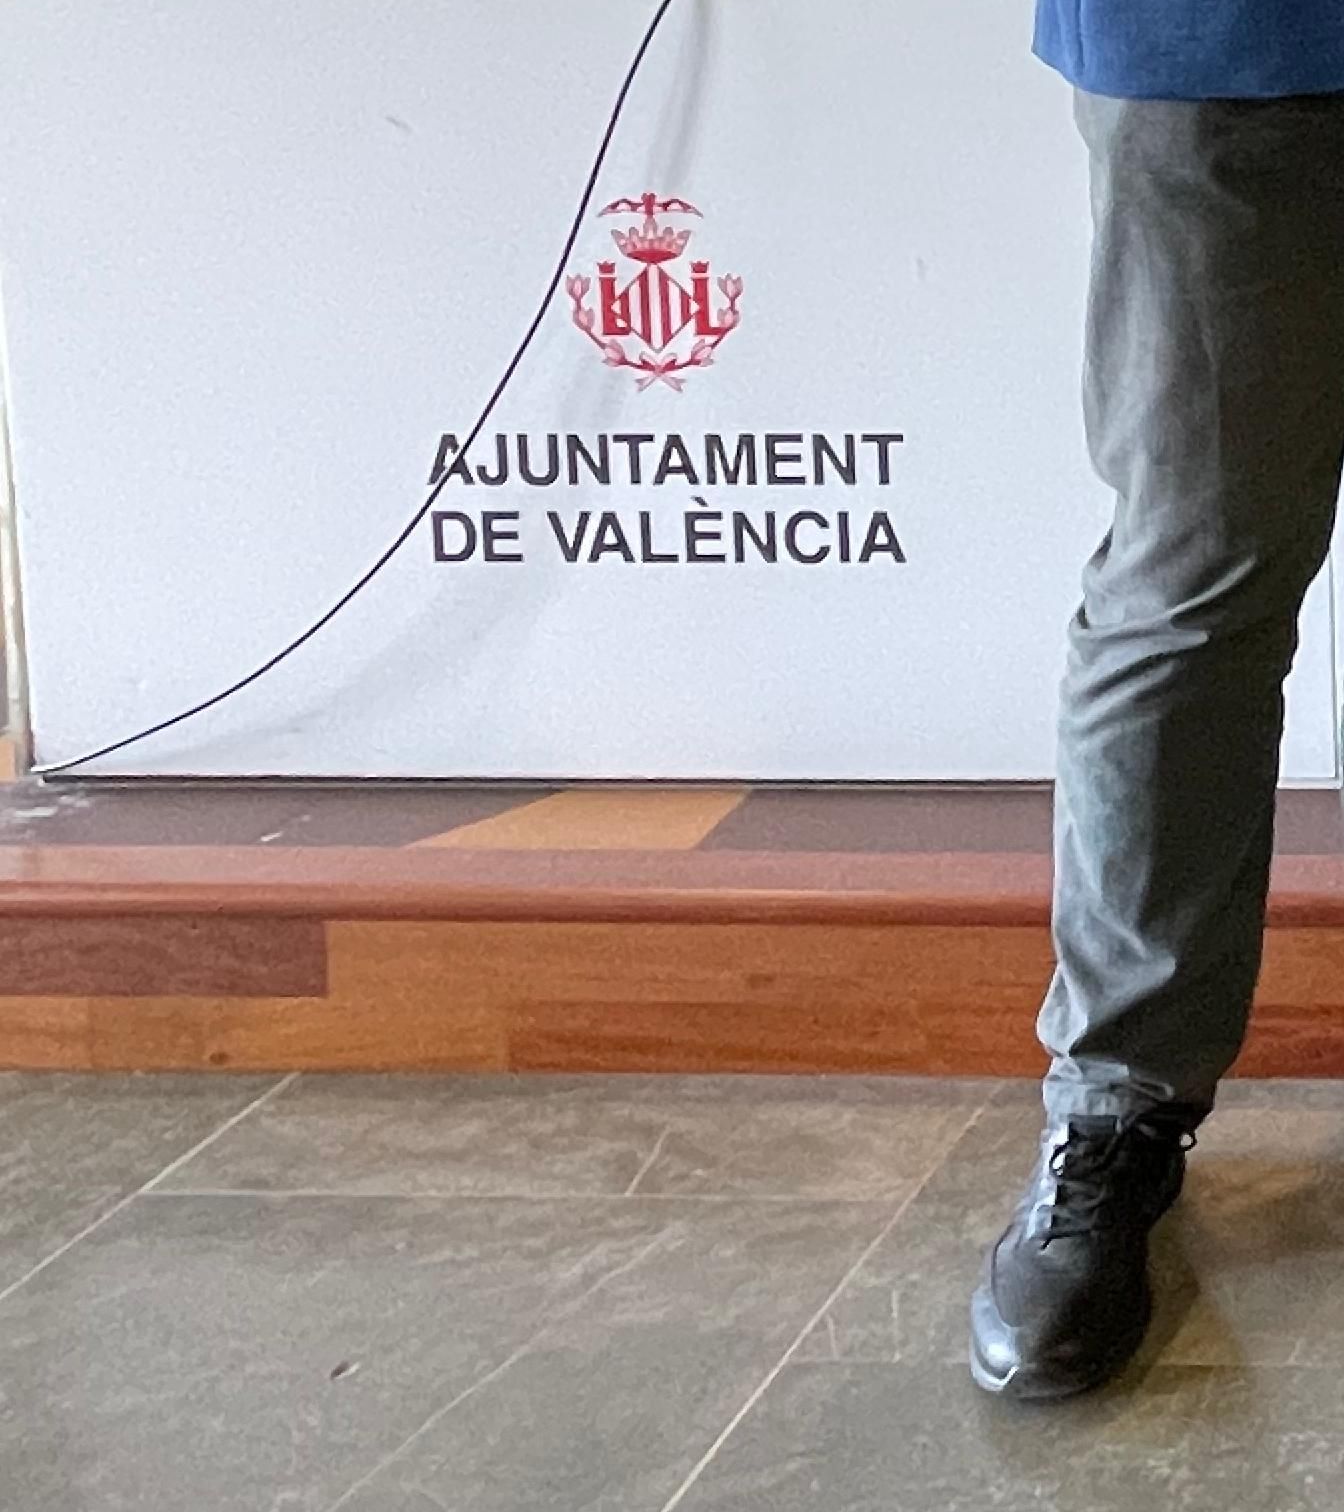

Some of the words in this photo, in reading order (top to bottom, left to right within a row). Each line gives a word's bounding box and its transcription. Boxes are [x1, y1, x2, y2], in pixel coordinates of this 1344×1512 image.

[426, 433, 905, 489] AJUNTAMENT
[431, 511, 523, 564] DE
[547, 496, 908, 564] VALÈNCIA
